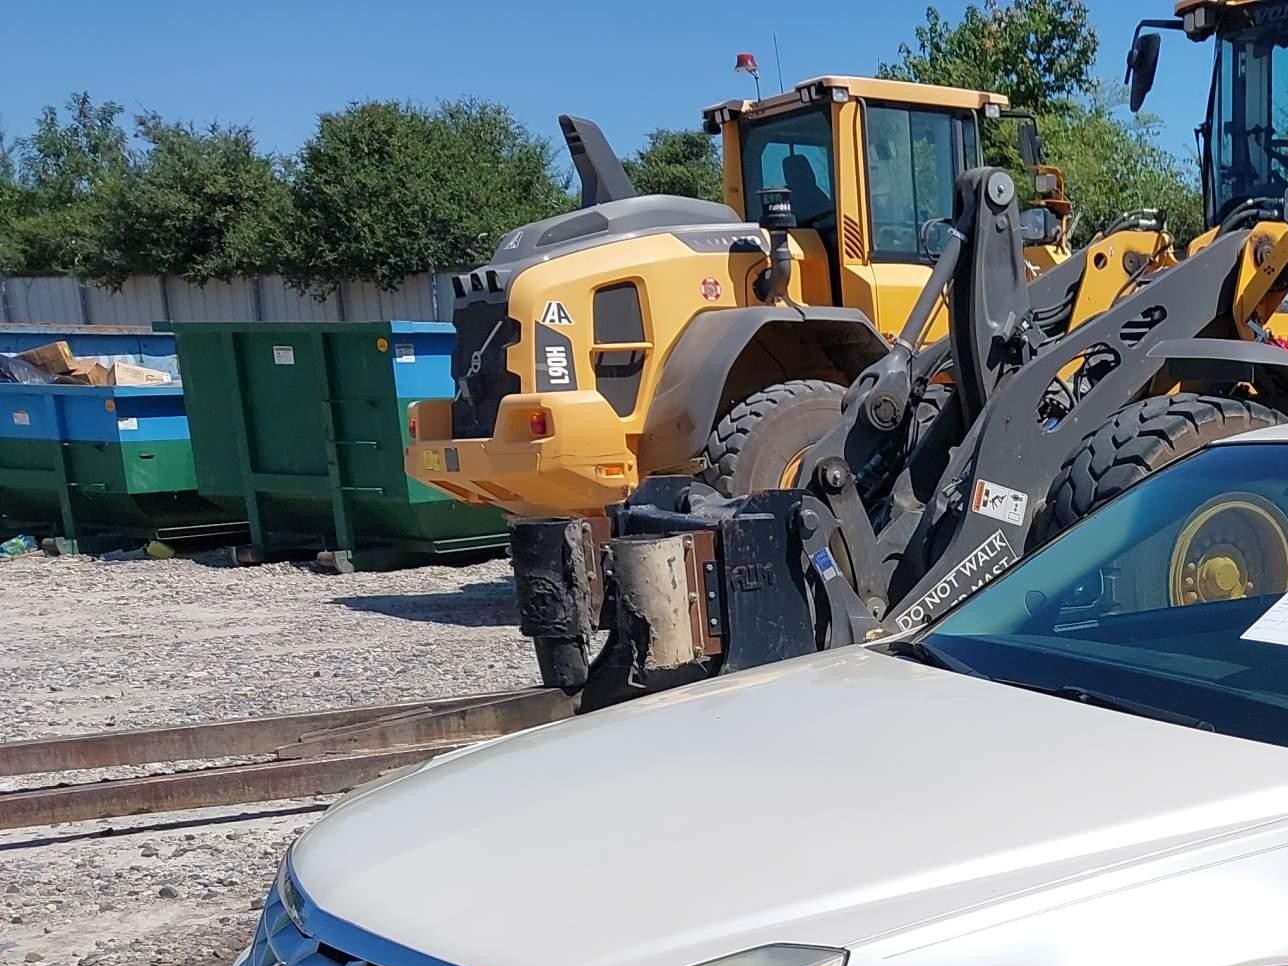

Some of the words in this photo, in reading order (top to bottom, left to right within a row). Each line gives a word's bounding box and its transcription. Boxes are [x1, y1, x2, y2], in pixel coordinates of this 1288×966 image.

[545, 346, 570, 385] L90H
[898, 606, 924, 631] DO
[924, 573, 959, 609] NOT
[960, 536, 1006, 577] WALK
